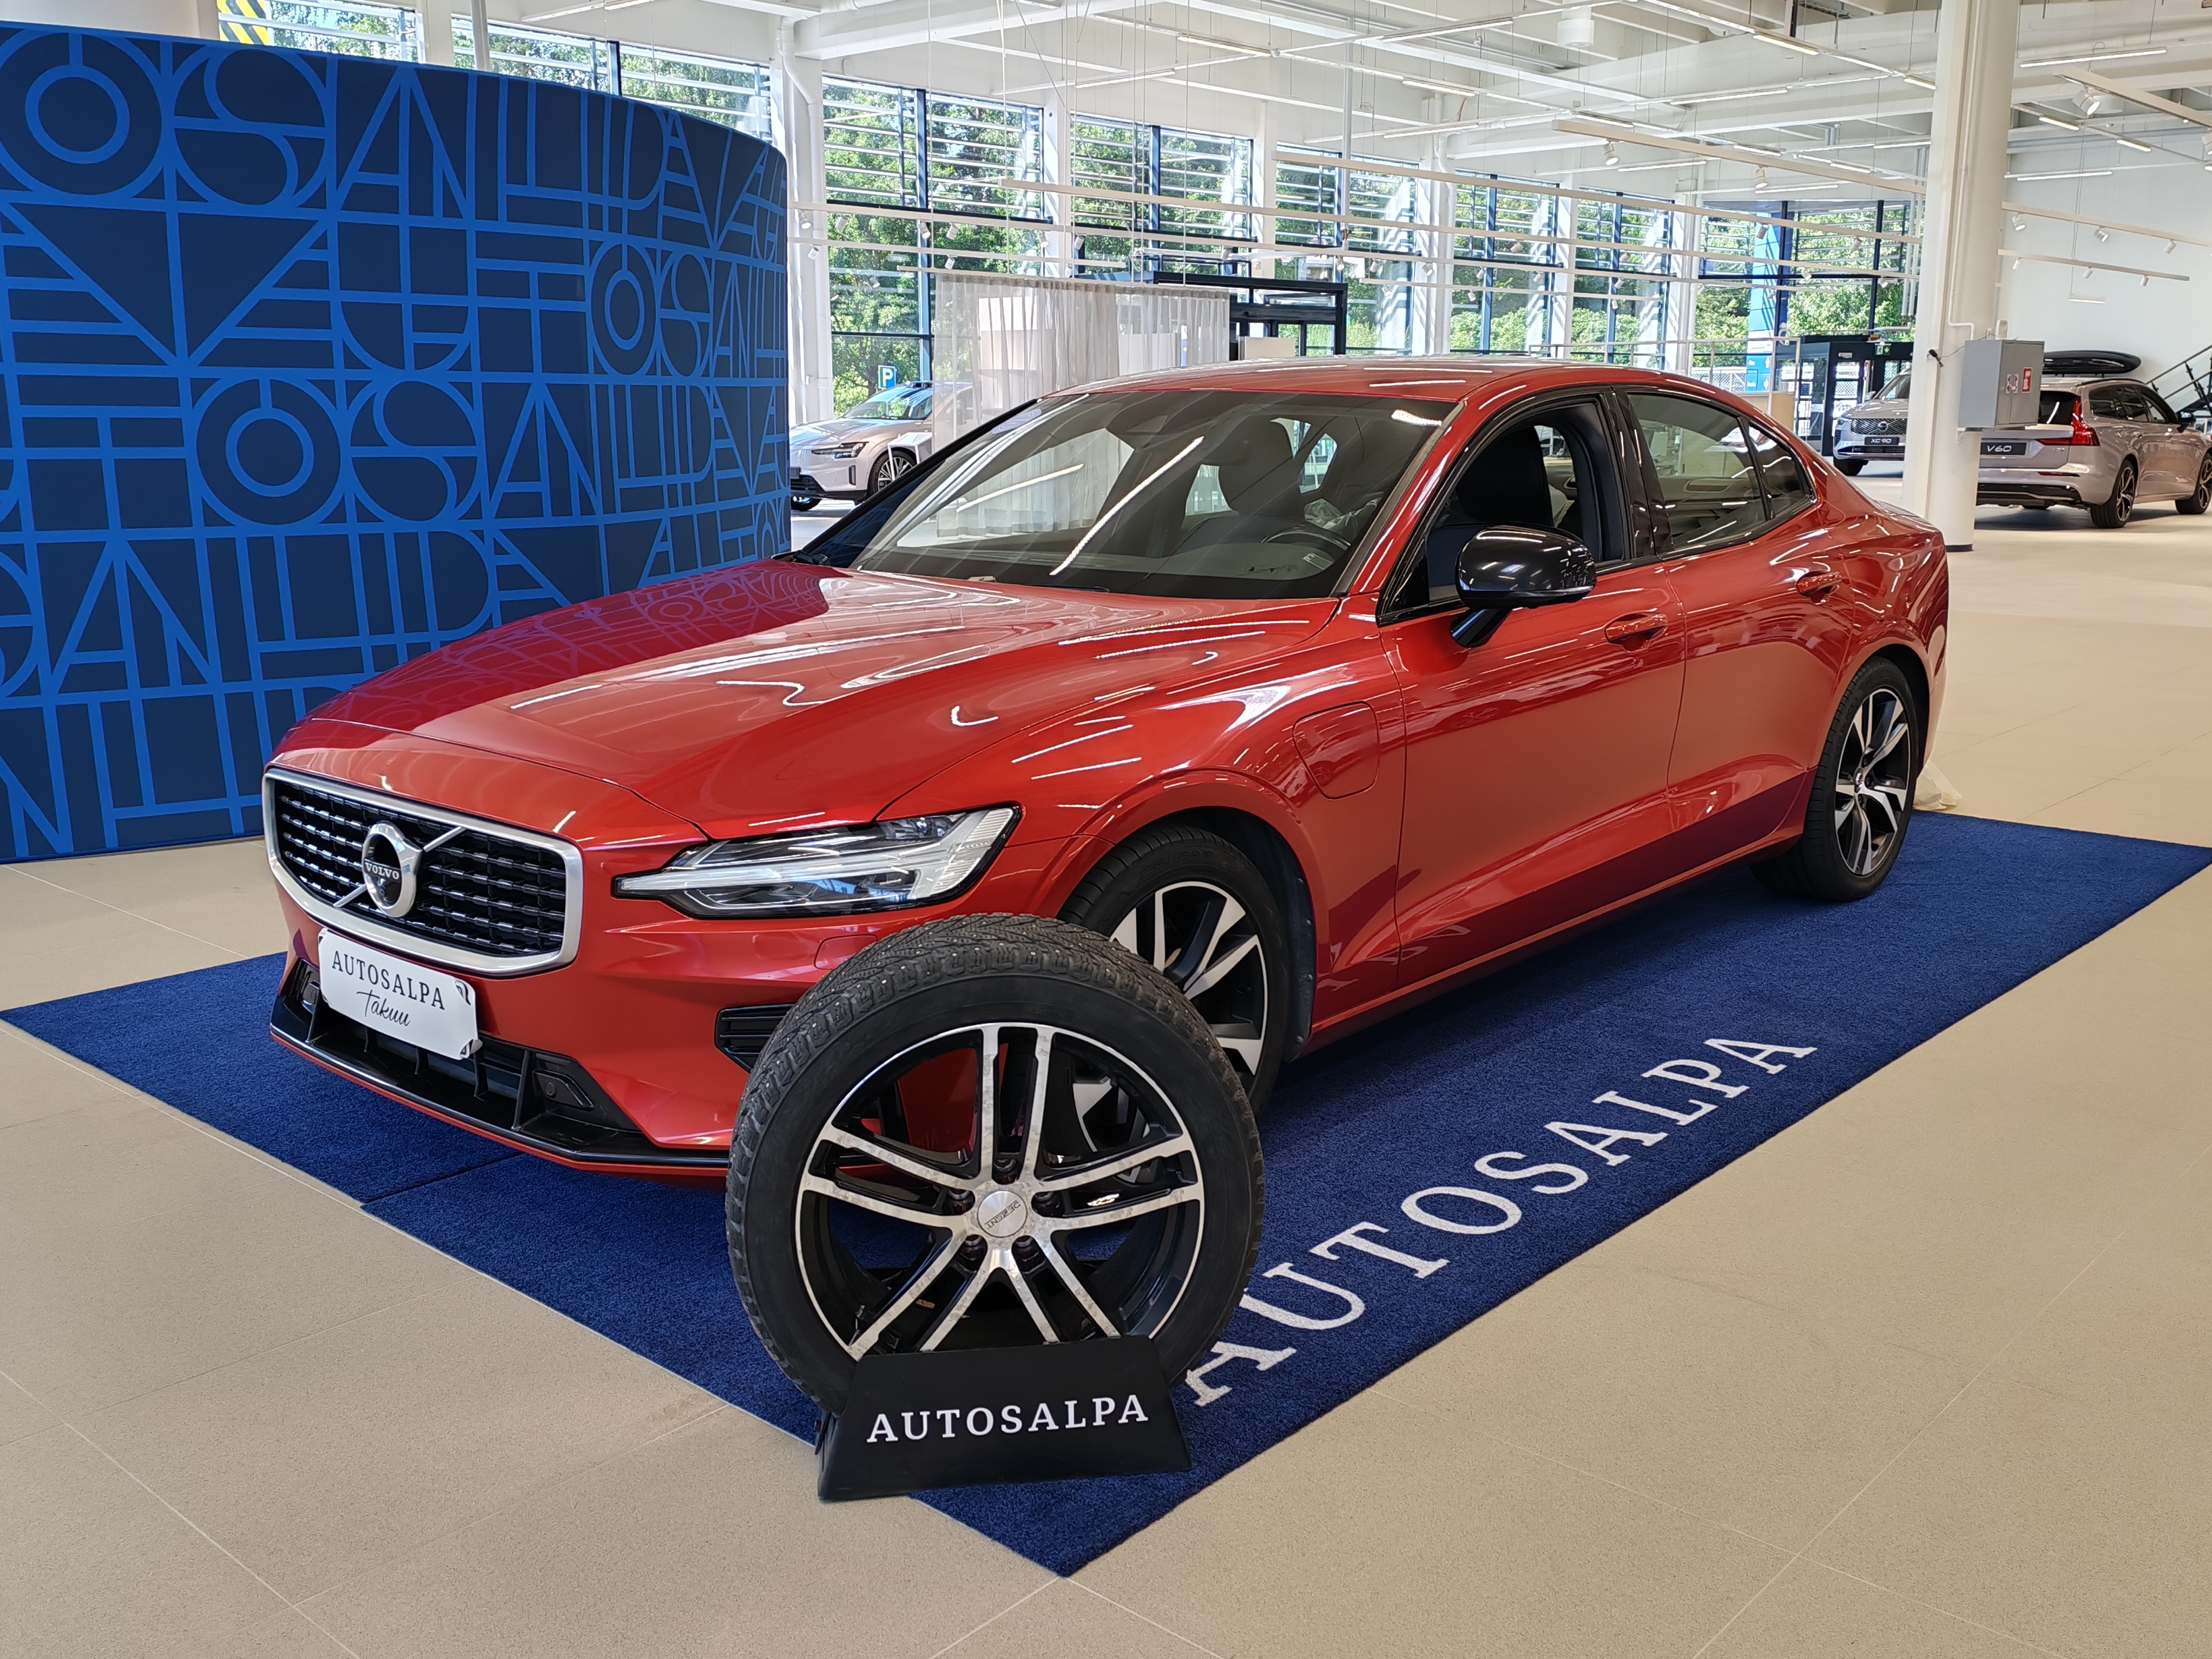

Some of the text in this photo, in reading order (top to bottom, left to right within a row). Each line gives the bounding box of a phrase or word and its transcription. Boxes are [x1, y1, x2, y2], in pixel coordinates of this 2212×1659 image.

[882, 368, 893, 387] P
[365, 862, 400, 880] VOLVO
[332, 950, 446, 1010] AUTOSALPA
[356, 989, 410, 1027] Takuu
[984, 1199, 1021, 1230] DEZENT
[866, 1394, 1149, 1443] AUTOSALPA
